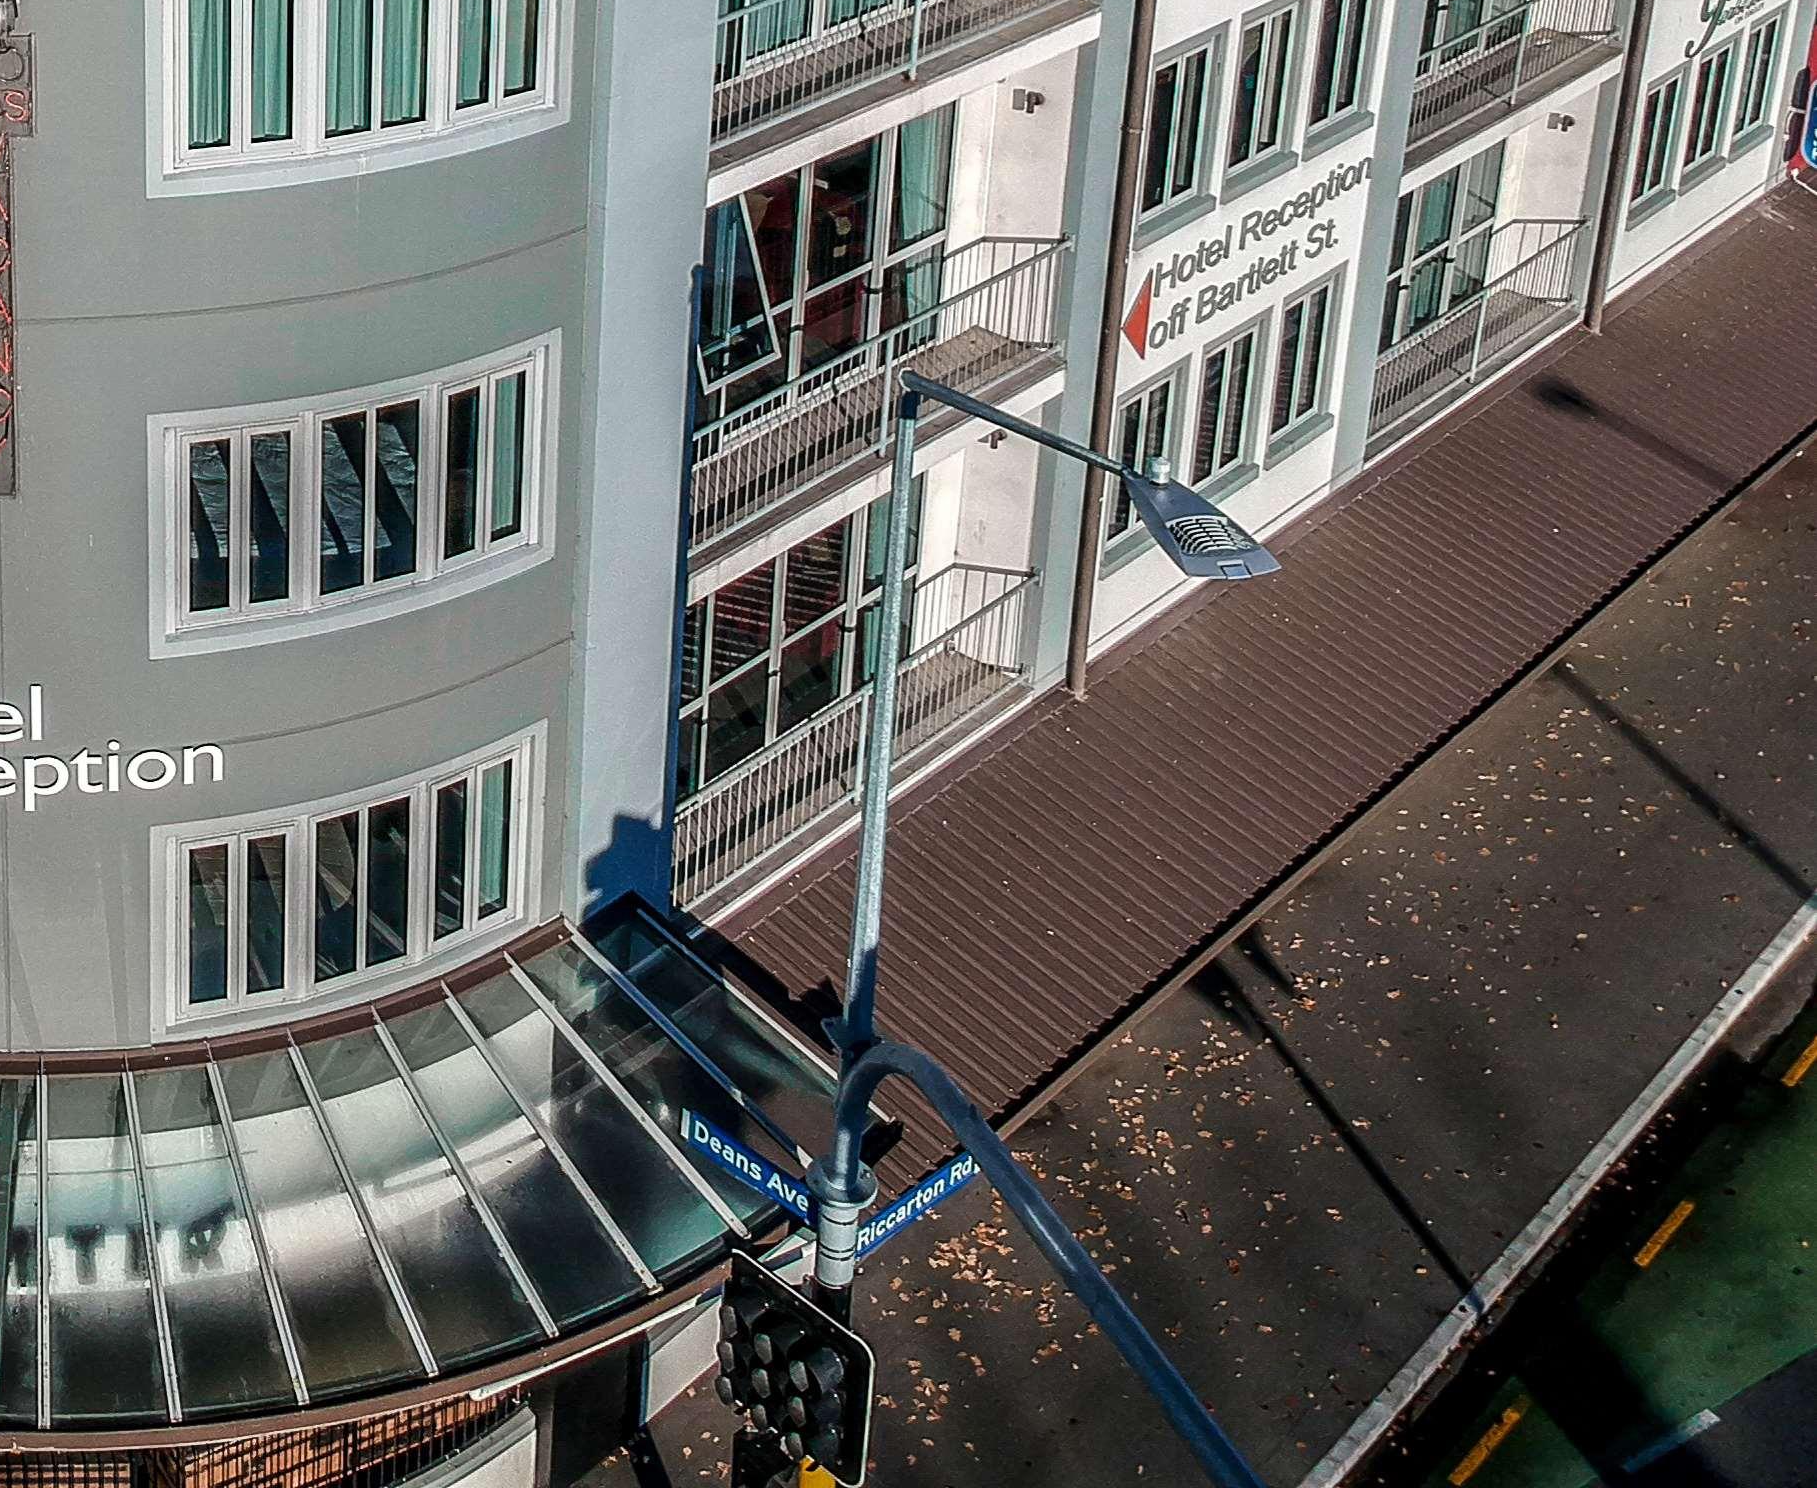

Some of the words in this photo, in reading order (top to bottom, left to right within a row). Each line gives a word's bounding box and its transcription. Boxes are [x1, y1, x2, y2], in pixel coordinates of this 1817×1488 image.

[1148, 297, 1192, 350] off
[1194, 239, 1299, 325] Bartlett
[1304, 218, 1340, 260] St.
[1153, 224, 1233, 298] Hotel
[1238, 157, 1374, 251] Reception
[693, 1119, 762, 1180] Deans
[766, 1172, 811, 1213] Ave
[856, 1180, 945, 1253] Riccarton
[948, 1155, 973, 1188] Rd
